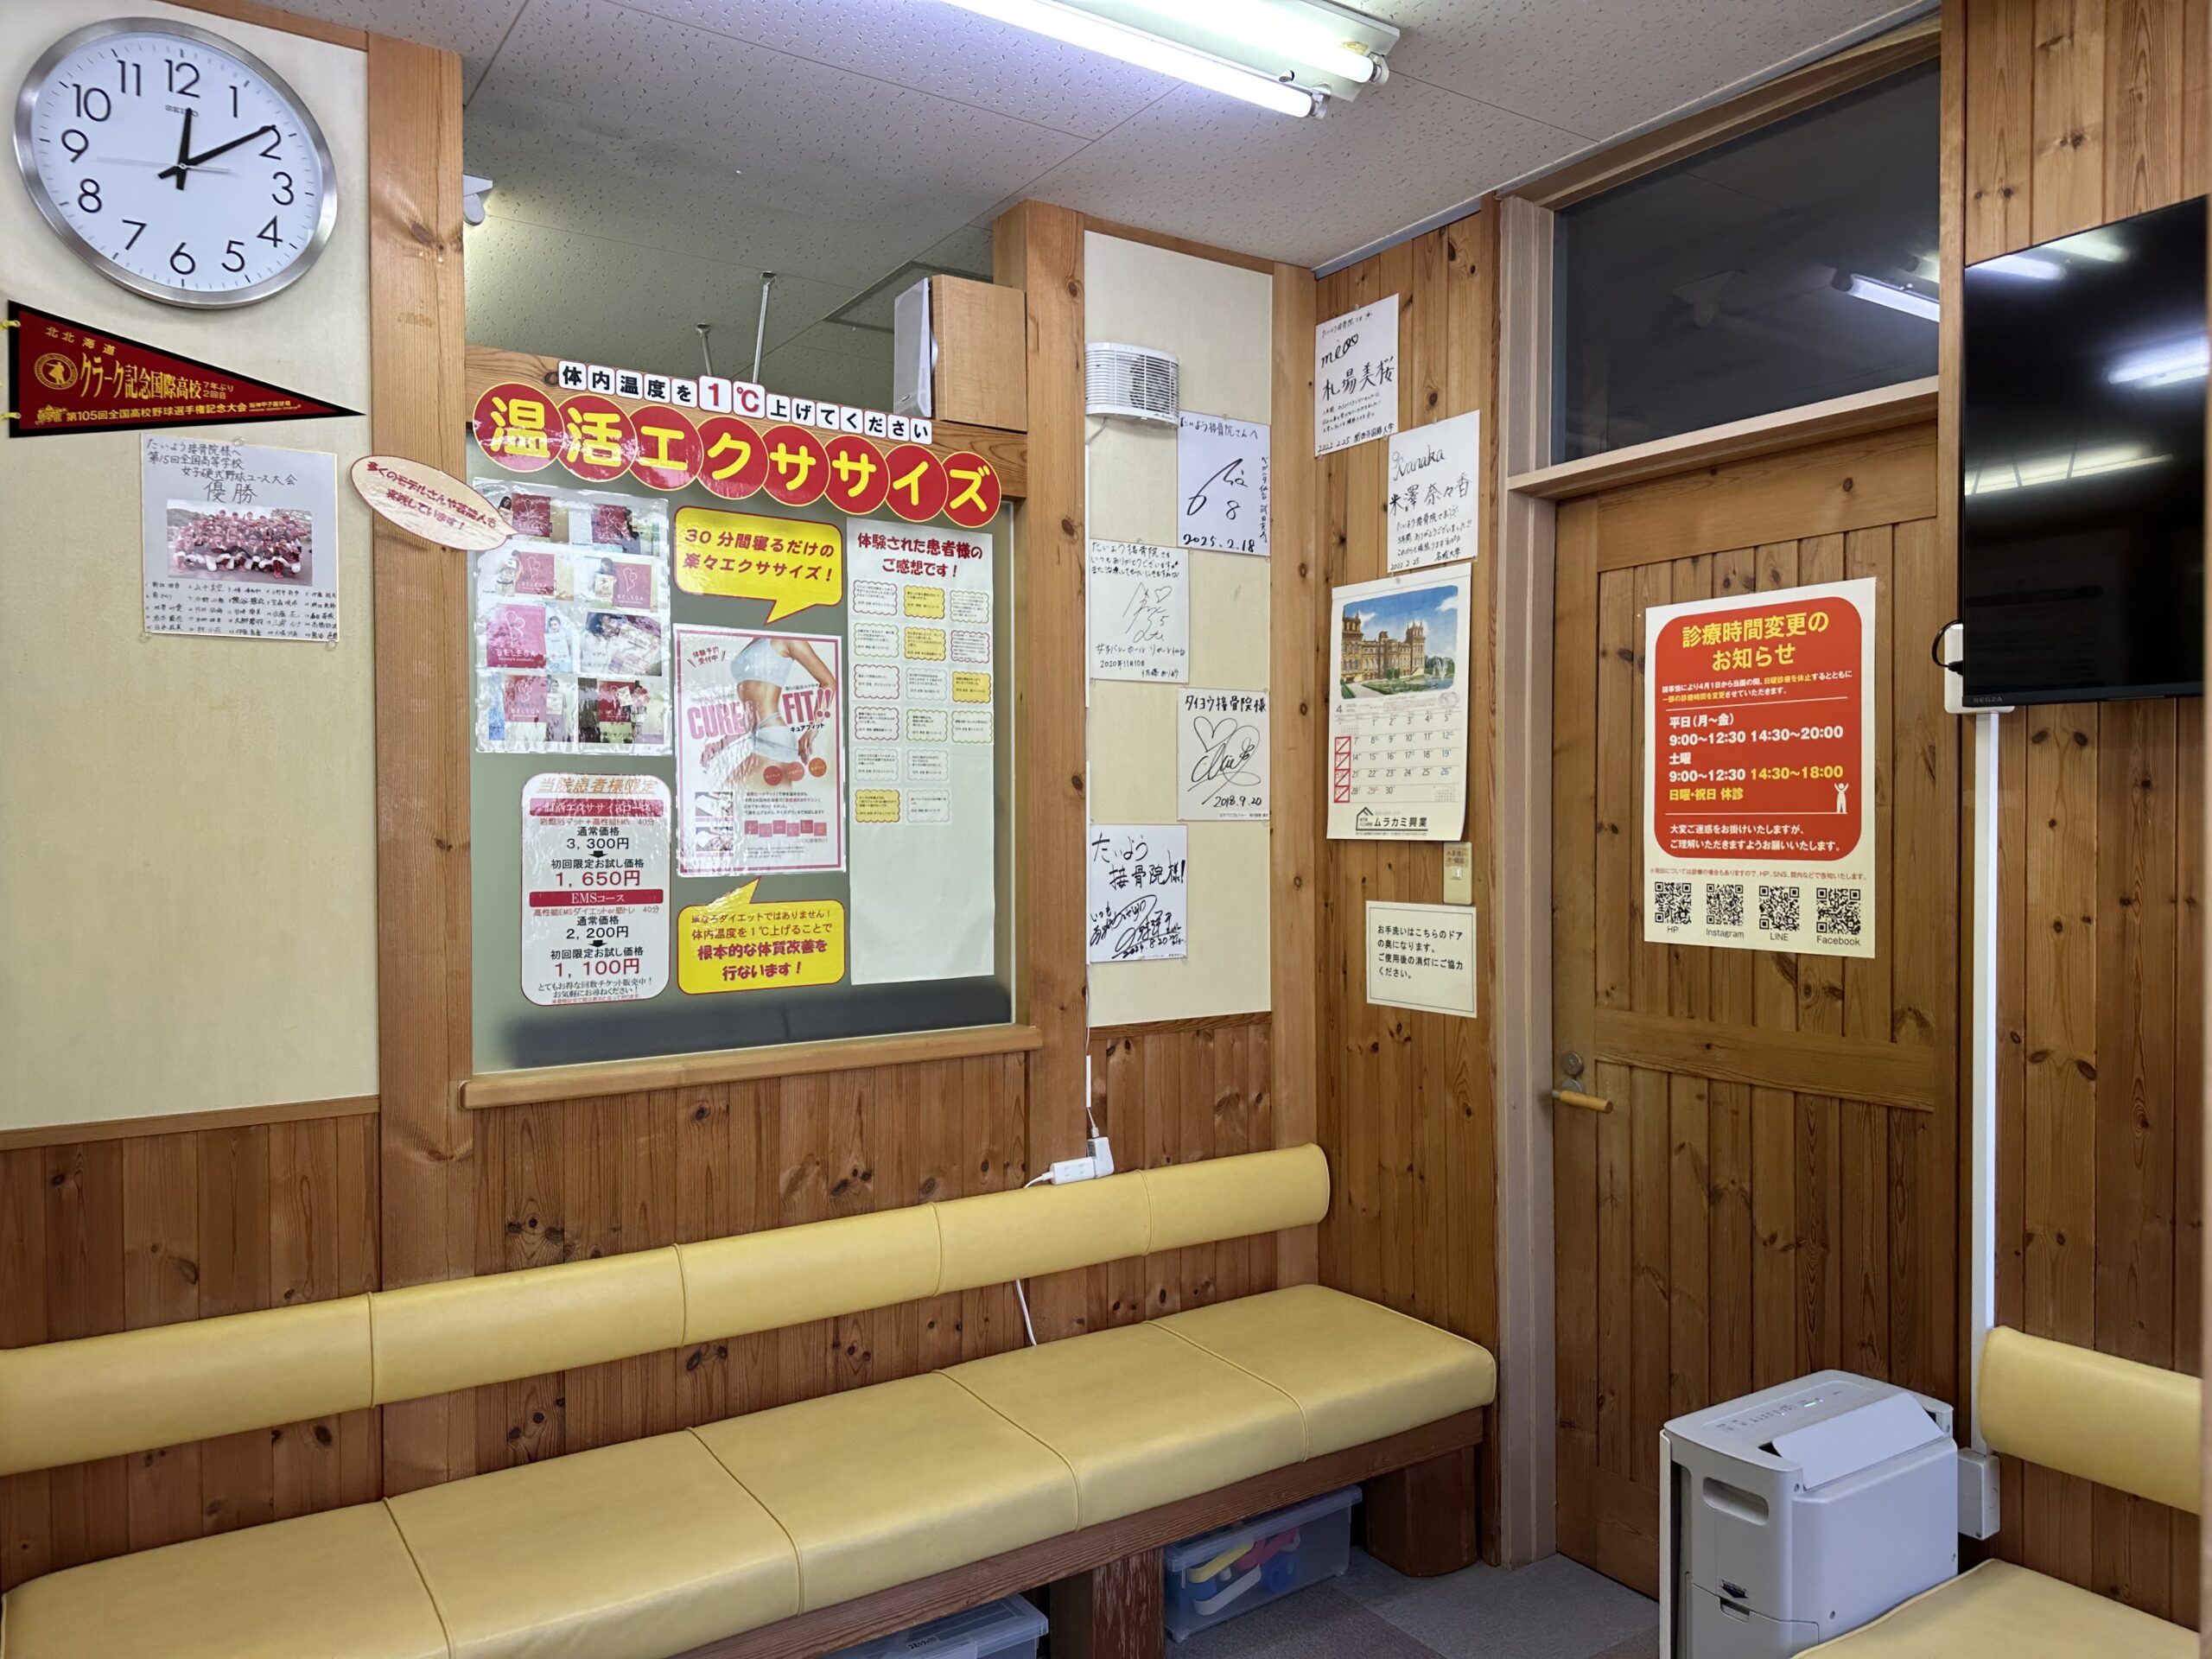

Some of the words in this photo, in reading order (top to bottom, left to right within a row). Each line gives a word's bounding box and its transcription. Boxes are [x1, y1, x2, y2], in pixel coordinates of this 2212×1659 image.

[117, 60, 141, 97] 11
[164, 59, 200, 99] 12
[73, 83, 111, 122] 10
[229, 85, 238, 118] 1
[60, 129, 89, 163] 9
[78, 178, 102, 213] 8
[271, 171, 295, 205] 3
[122, 219, 147, 251] 7
[257, 215, 283, 248] 4
[169, 242, 196, 275] 6
[221, 240, 245, 272] 5
[80, 352, 202, 400] クラーク記念国際高校
[66, 403, 248, 423] 第105回全国高校野球選手権記念大会
[562, 365, 931, 442] 体内温度を1℃上げてください
[149, 451, 245, 470] 第15回全国高等学校
[489, 395, 992, 514] 温活エクササイズ
[181, 467, 297, 486] 女子硬式野球ユース大会
[204, 481, 258, 505] 優勝
[367, 461, 497, 529] 多くのモデルさんや芸能人を
[858, 532, 983, 560] 体験された患者様の
[1183, 533, 1255, 553] 2025.2.18
[882, 558, 958, 578] ご感想です！
[1682, 611, 1829, 648] 診療時間変更の
[1713, 643, 1796, 671] お知らせ
[1185, 695, 1267, 713] タイヨウ接骨院様
[687, 701, 746, 740] CURE
[790, 723, 825, 733] キュアフィット
[1669, 752, 1692, 765] 土曜
[1213, 795, 1262, 807] 2018.9.20
[1669, 788, 1717, 801] 日曜・祝日
[1721, 787, 1744, 800] 休診
[577, 826, 620, 836] 通常価格
[1374, 817, 1427, 827] ムラカミ興業
[1669, 824, 1804, 836] 大変ご迷惑をお掛けいたしますが、
[566, 837, 629, 850] 3,300円
[1669, 839, 1840, 852] ご理解いただきますようお願いいたします。
[550, 858, 645, 869] 初回限定お試し価格
[556, 870, 640, 887] 1,650円
[571, 893, 626, 905] EMSコース
[577, 915, 619, 926] 通常価格
[566, 925, 629, 940] 2,200円
[1377, 925, 1463, 941] お手洗いはこちらのドア
[1707, 928, 1745, 938] Instagram
[1770, 932, 1789, 941] LINE
[1816, 936, 1860, 946] Facebook
[550, 946, 644, 960] 初回限定お試し価格
[697, 938, 828, 961] 根本的な体質改善を
[1377, 939, 1435, 953] の奥になります。
[555, 958, 640, 978] 1,100円
[1378, 952, 1464, 970] ご使用後の消灯にご協力
[722, 961, 802, 982] 行ないます！
[1378, 966, 1411, 979] ください。
